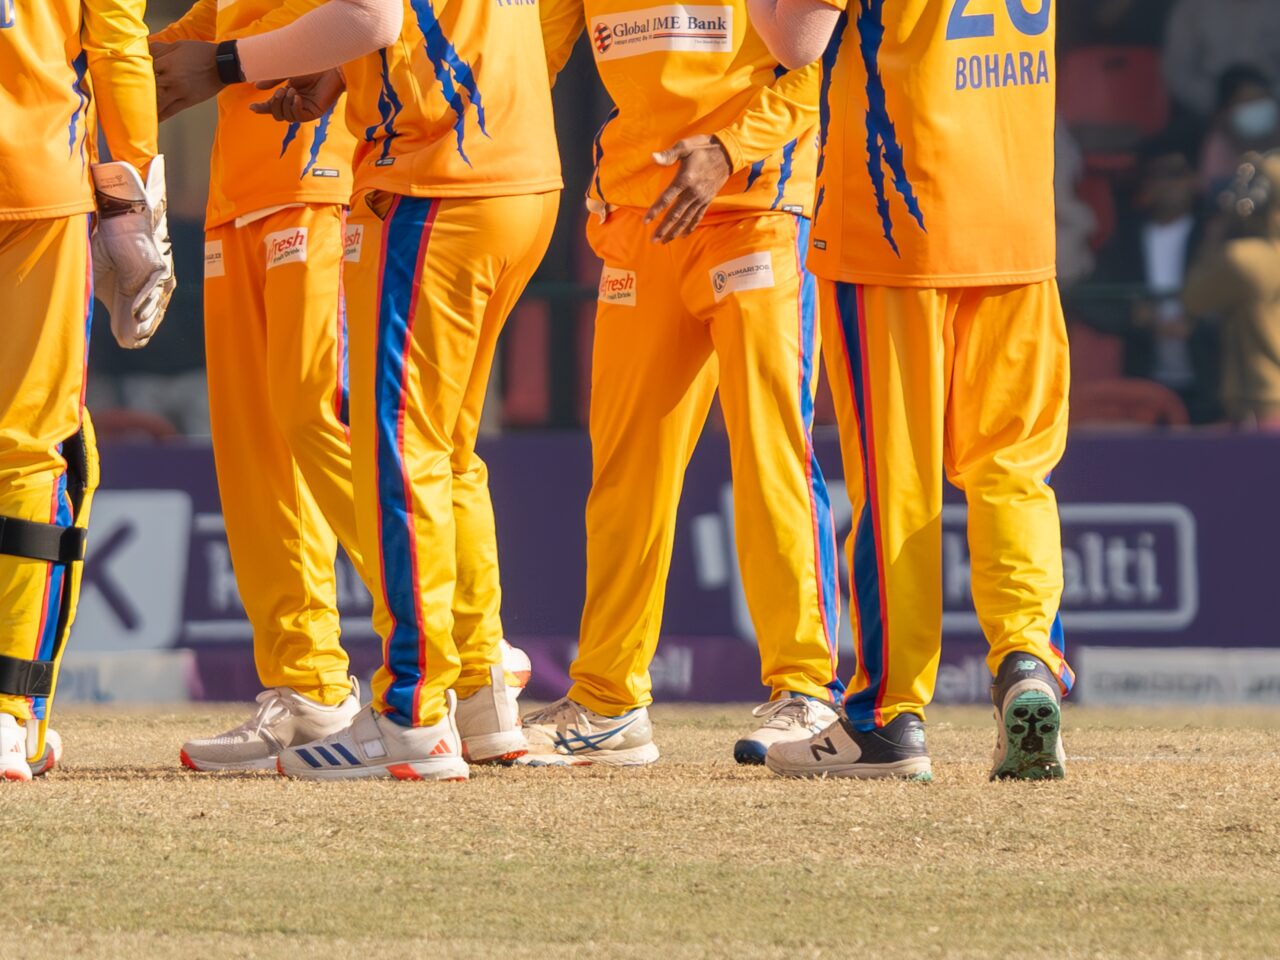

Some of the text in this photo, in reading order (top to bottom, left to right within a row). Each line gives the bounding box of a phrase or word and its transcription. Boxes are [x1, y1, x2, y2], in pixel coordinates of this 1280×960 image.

[613, 15, 727, 38] Global IME Bank
[955, 50, 1049, 91] BOHARA
